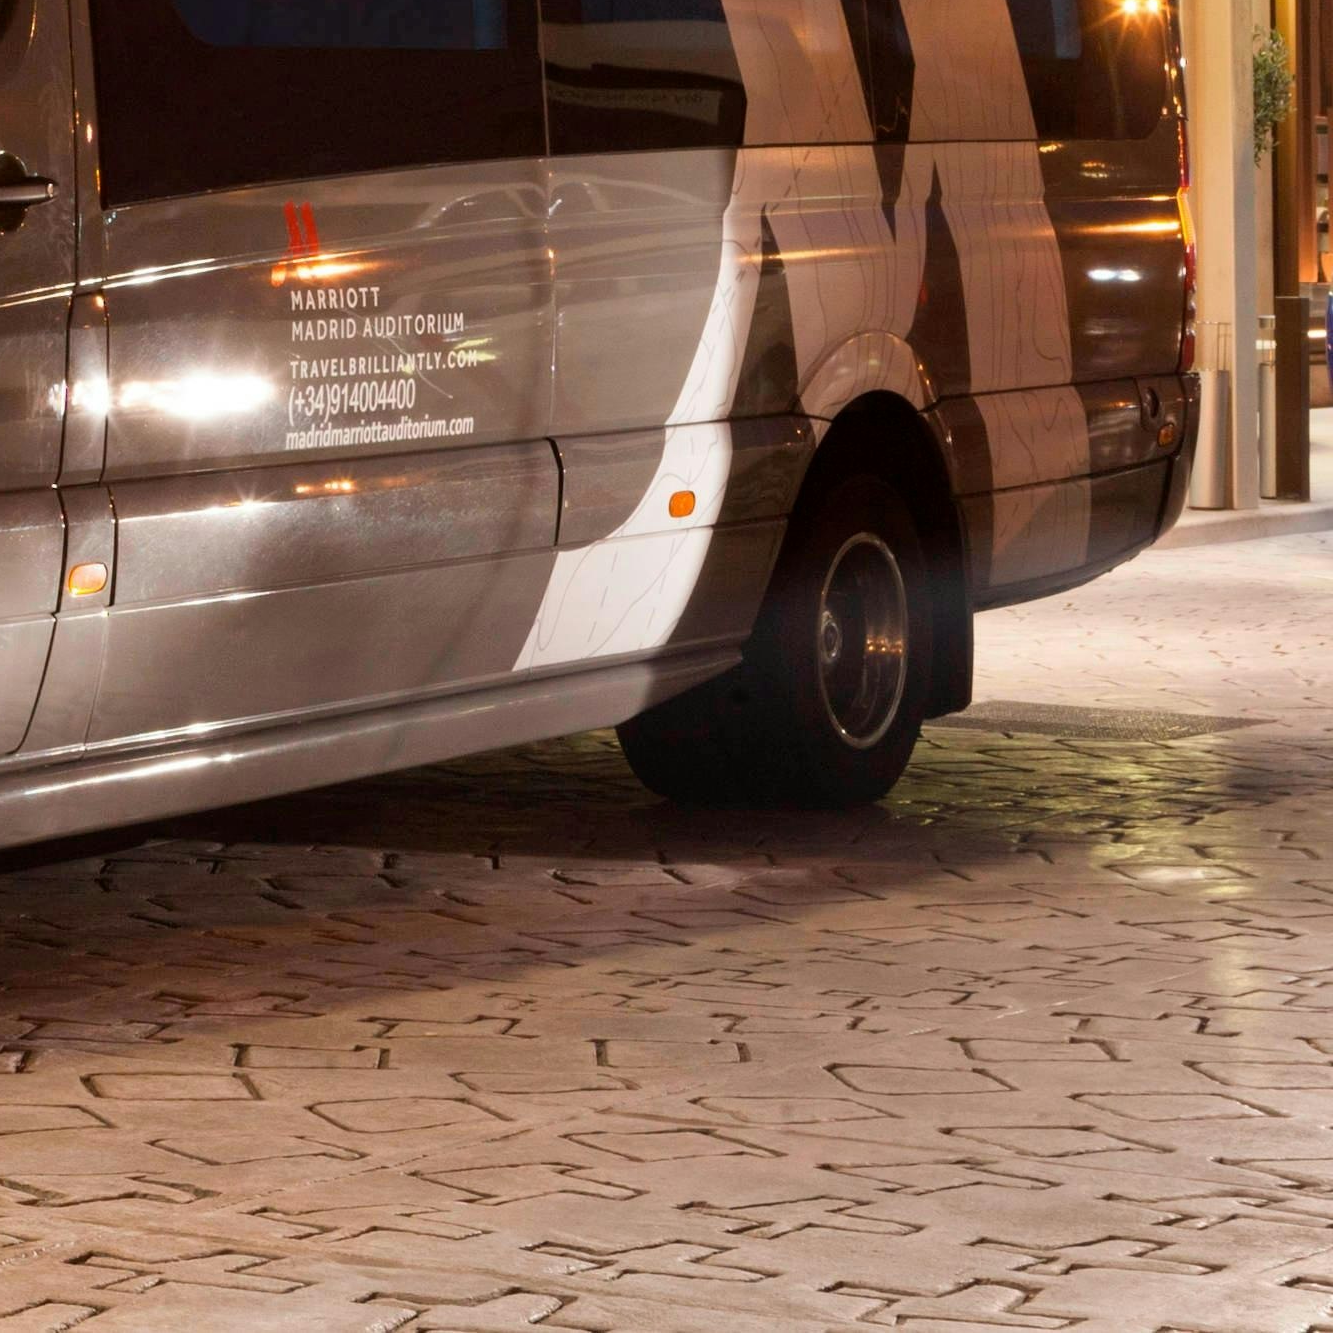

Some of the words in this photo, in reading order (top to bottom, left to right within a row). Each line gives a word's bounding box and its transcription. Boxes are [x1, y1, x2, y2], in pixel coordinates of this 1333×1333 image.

[290, 286, 381, 311] MARRIOTT
[291, 318, 357, 342] MADRID
[362, 312, 465, 338] AUDITORIUM
[290, 349, 478, 379] TRAVELBRILLIANTLY.COM
[287, 378, 416, 426] (+34)914004400
[285, 414, 474, 450] madridmarriottauditorium.com
